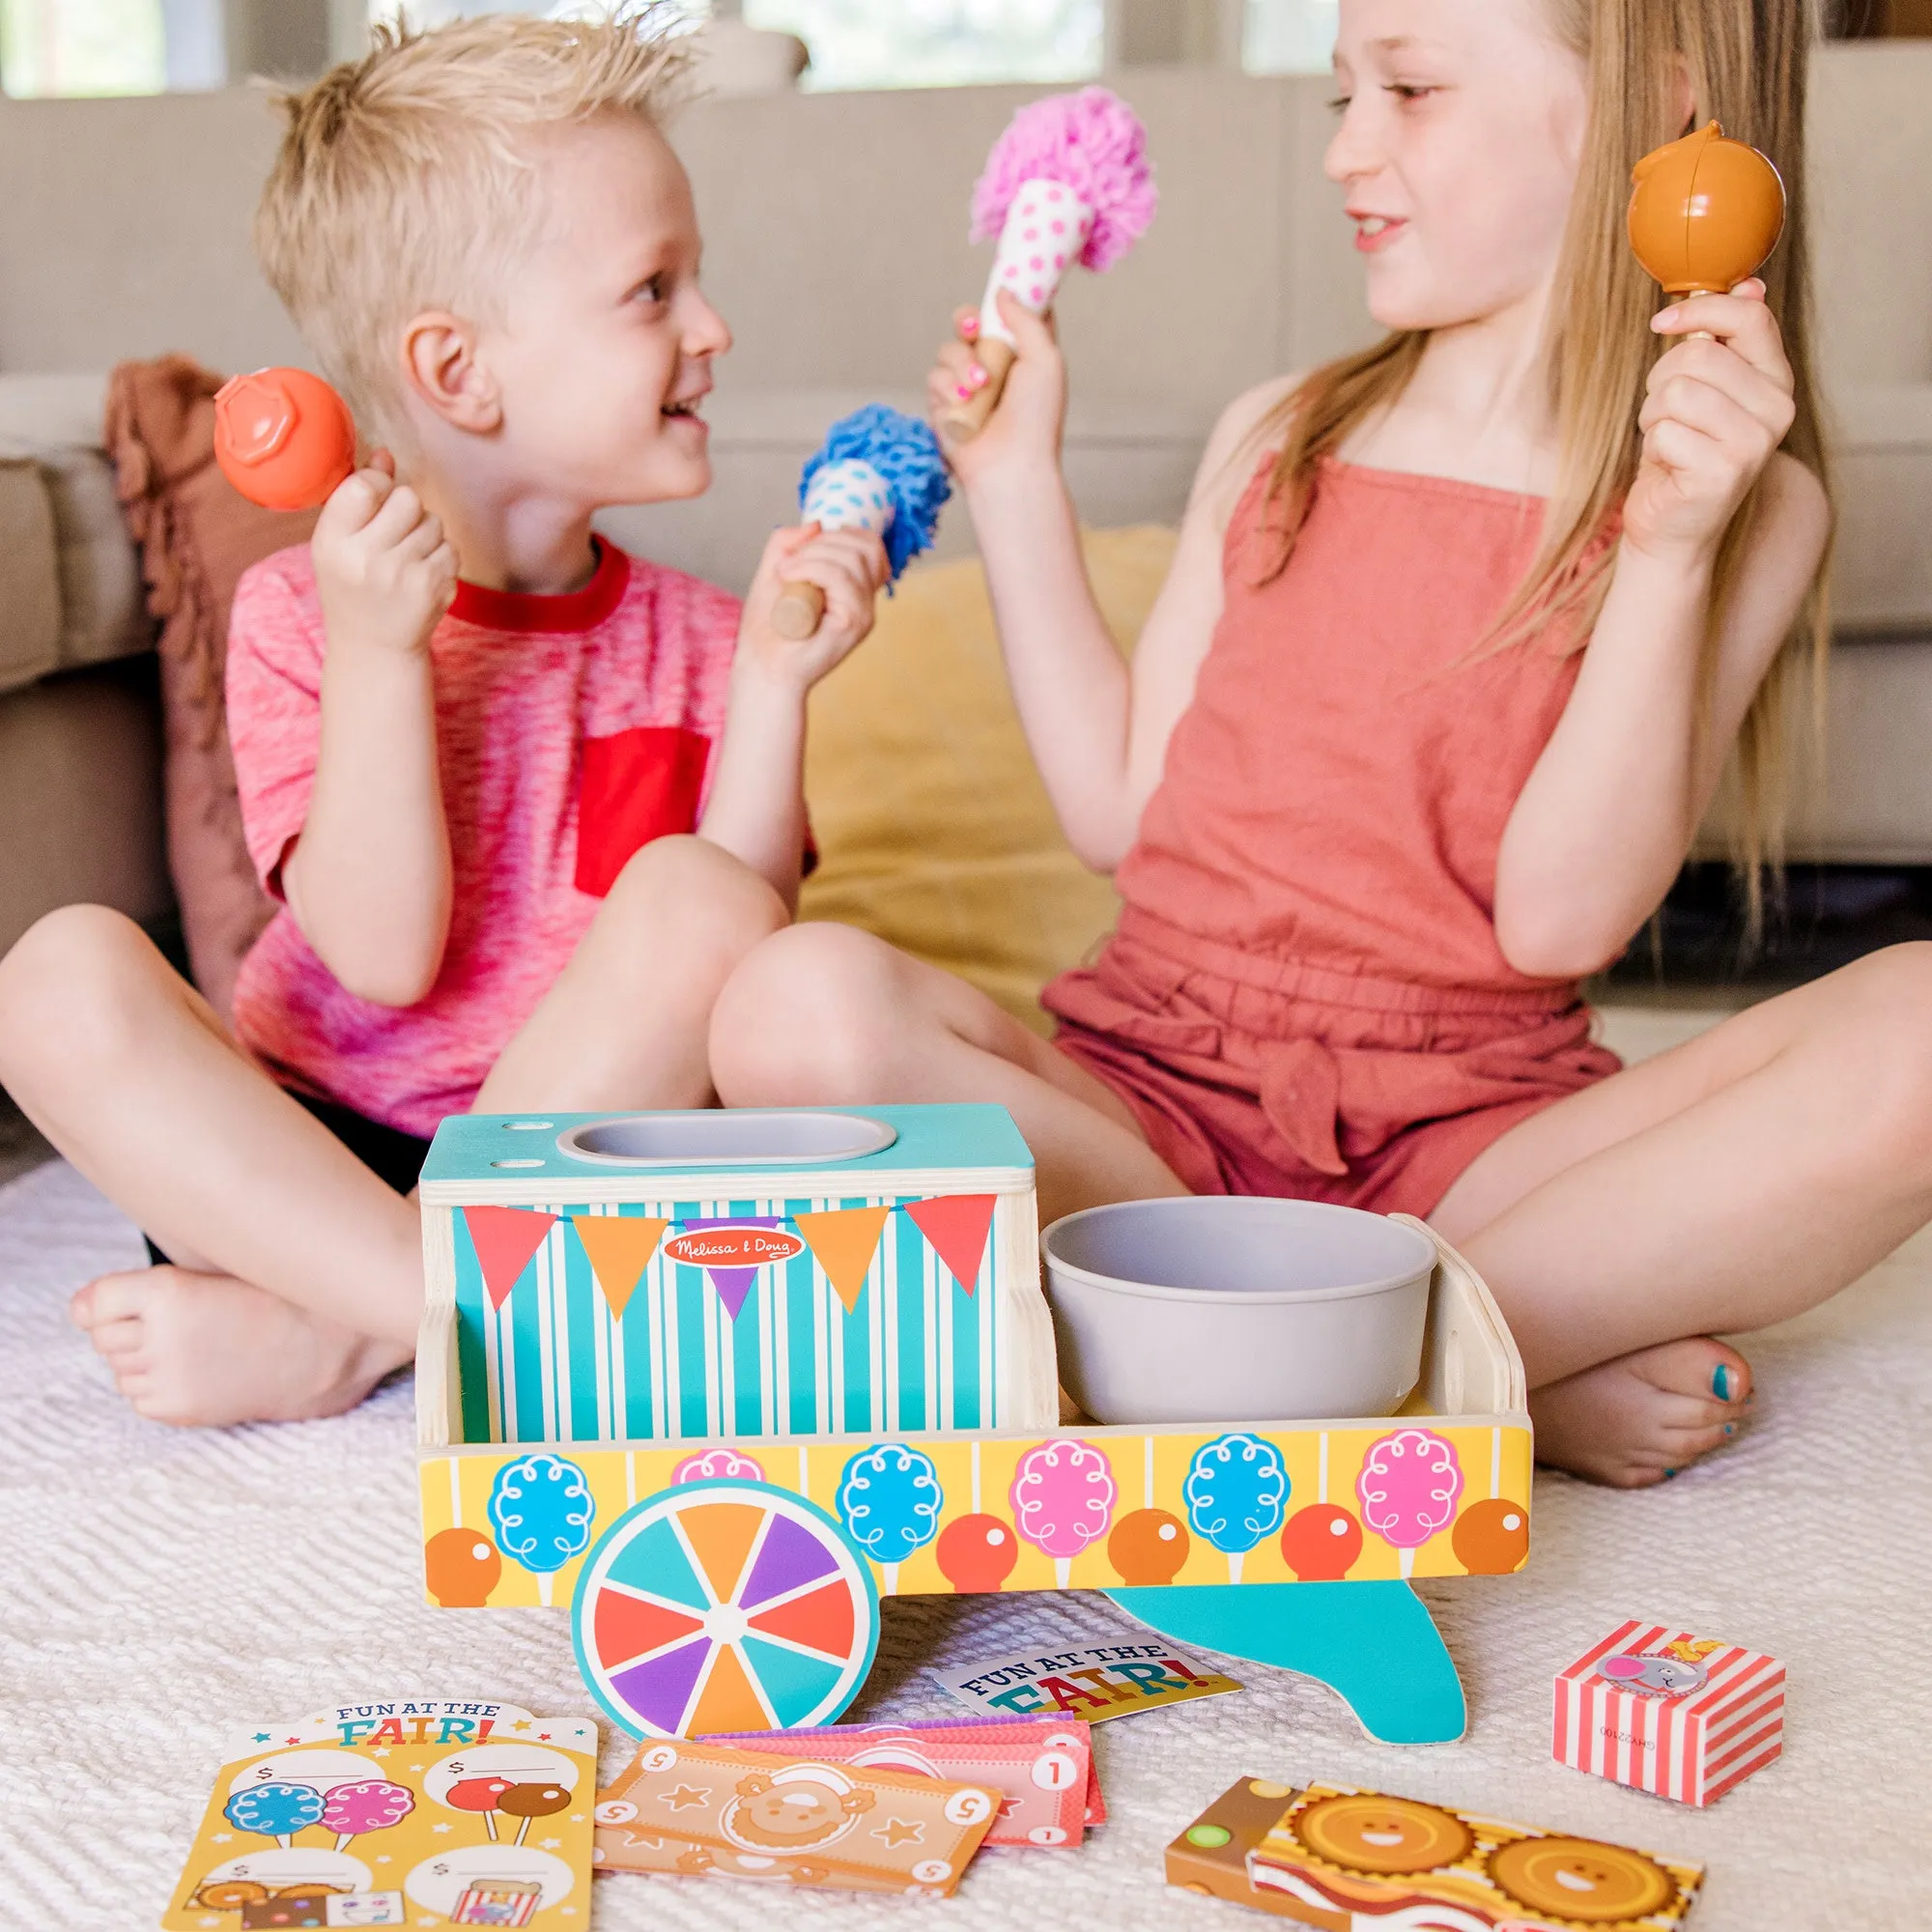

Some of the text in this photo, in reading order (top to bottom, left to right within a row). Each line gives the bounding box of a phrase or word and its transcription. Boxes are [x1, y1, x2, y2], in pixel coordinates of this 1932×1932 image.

[675, 1238, 738, 1259] Melissa
[754, 1237, 791, 1259] Doug
[958, 1645, 1169, 1696] FUN AT THE
[986, 1660, 1210, 1714] FAIR!
[336, 1703, 500, 1719] FUN AT THE
[336, 1717, 496, 1747] FAIR!
[447, 1761, 465, 1775] $
[649, 1752, 668, 1768] 5
[256, 1767, 273, 1780] $
[1049, 1762, 1060, 1785] 1
[602, 1805, 629, 1820] 5
[956, 1797, 980, 1819] 5
[1043, 1831, 1052, 1841] 1
[231, 1863, 249, 1877] $
[432, 1863, 449, 1876] $
[923, 1864, 943, 1878] 5
